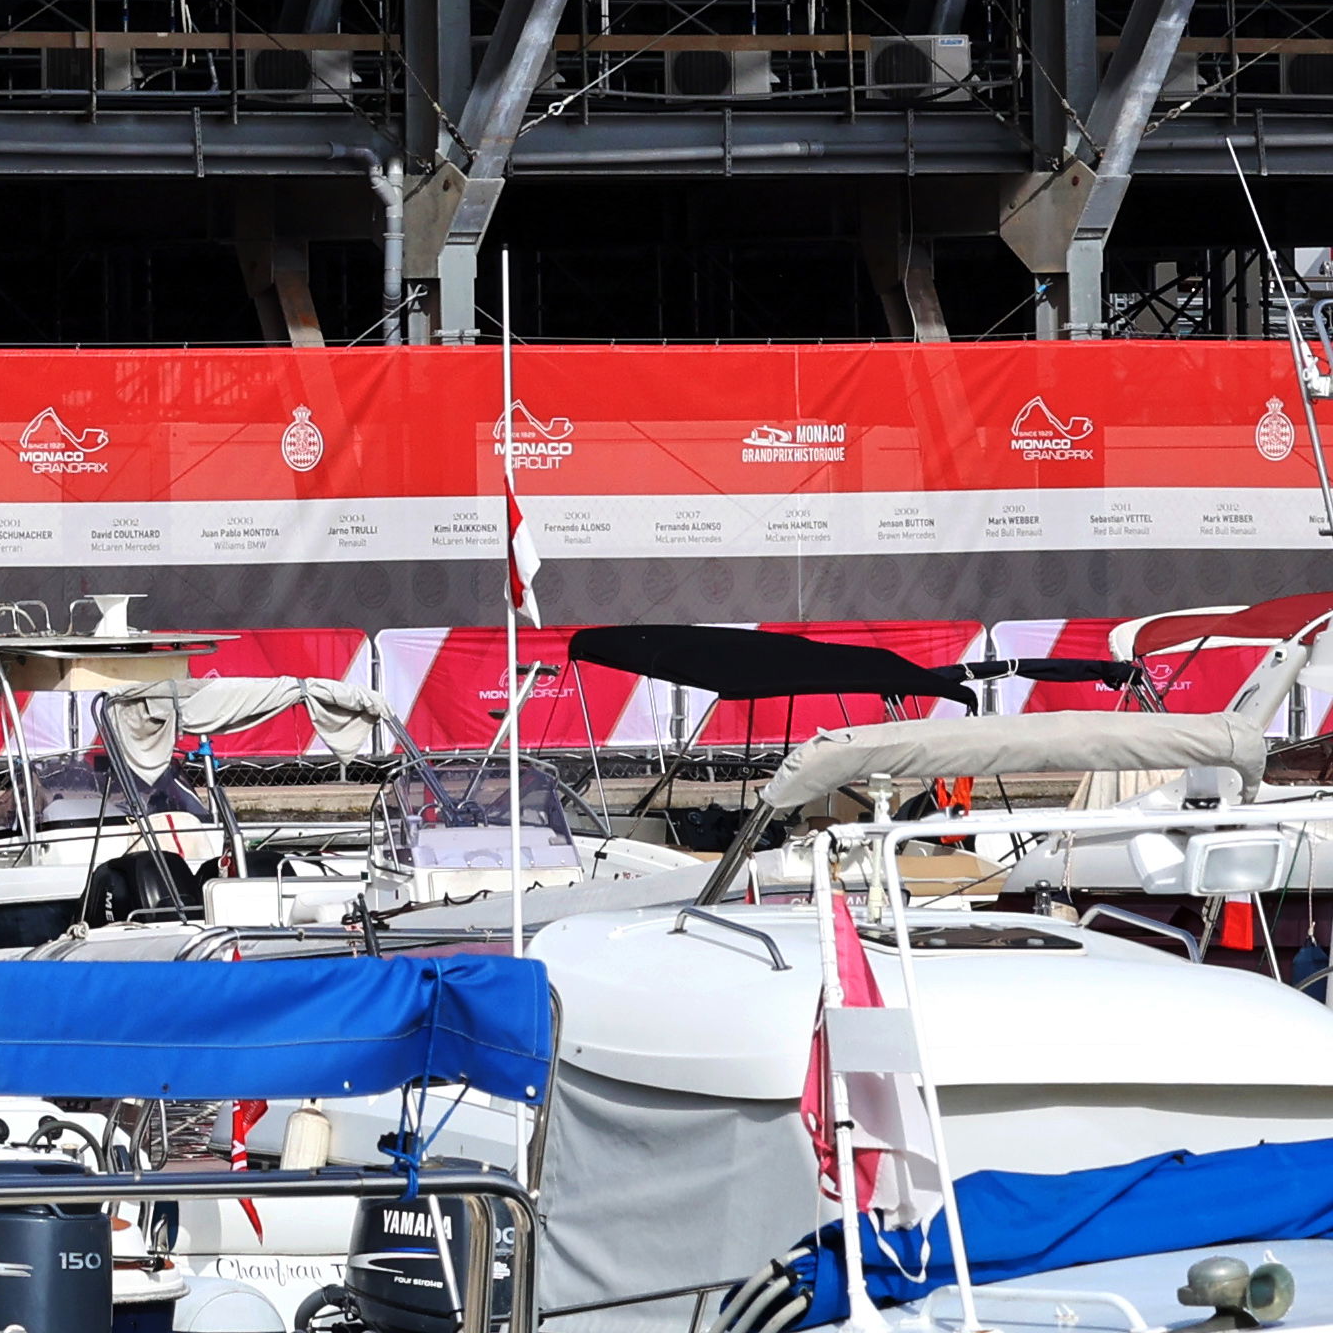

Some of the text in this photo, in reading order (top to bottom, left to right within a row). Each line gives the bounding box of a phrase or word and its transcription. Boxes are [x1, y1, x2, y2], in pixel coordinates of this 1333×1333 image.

[796, 425, 844, 443] MONACO
[1011, 439, 1070, 450] MONACO
[19, 451, 84, 462] MONACO
[878, 519, 934, 528] Jenson BUTTON
[989, 516, 1039, 525] Mark WEBBER
[1090, 514, 1152, 524] Sebastian VETTEL
[1203, 515, 1253, 523] Mark WEBBER
[434, 524, 451, 532] Kimi
[544, 523, 610, 532] Fernando ALONSO
[655, 522, 721, 531] Fernando ALONSO
[768, 521, 828, 530] Lewis HAMILTON
[91, 530, 160, 539] David COULTHARD
[200, 528, 279, 538] Juan Pablo MONTOYA
[327, 526, 377, 535] Jarno TRULLI
[214, 541, 246, 550] Williams
[59, 1252, 102, 1270] 150
